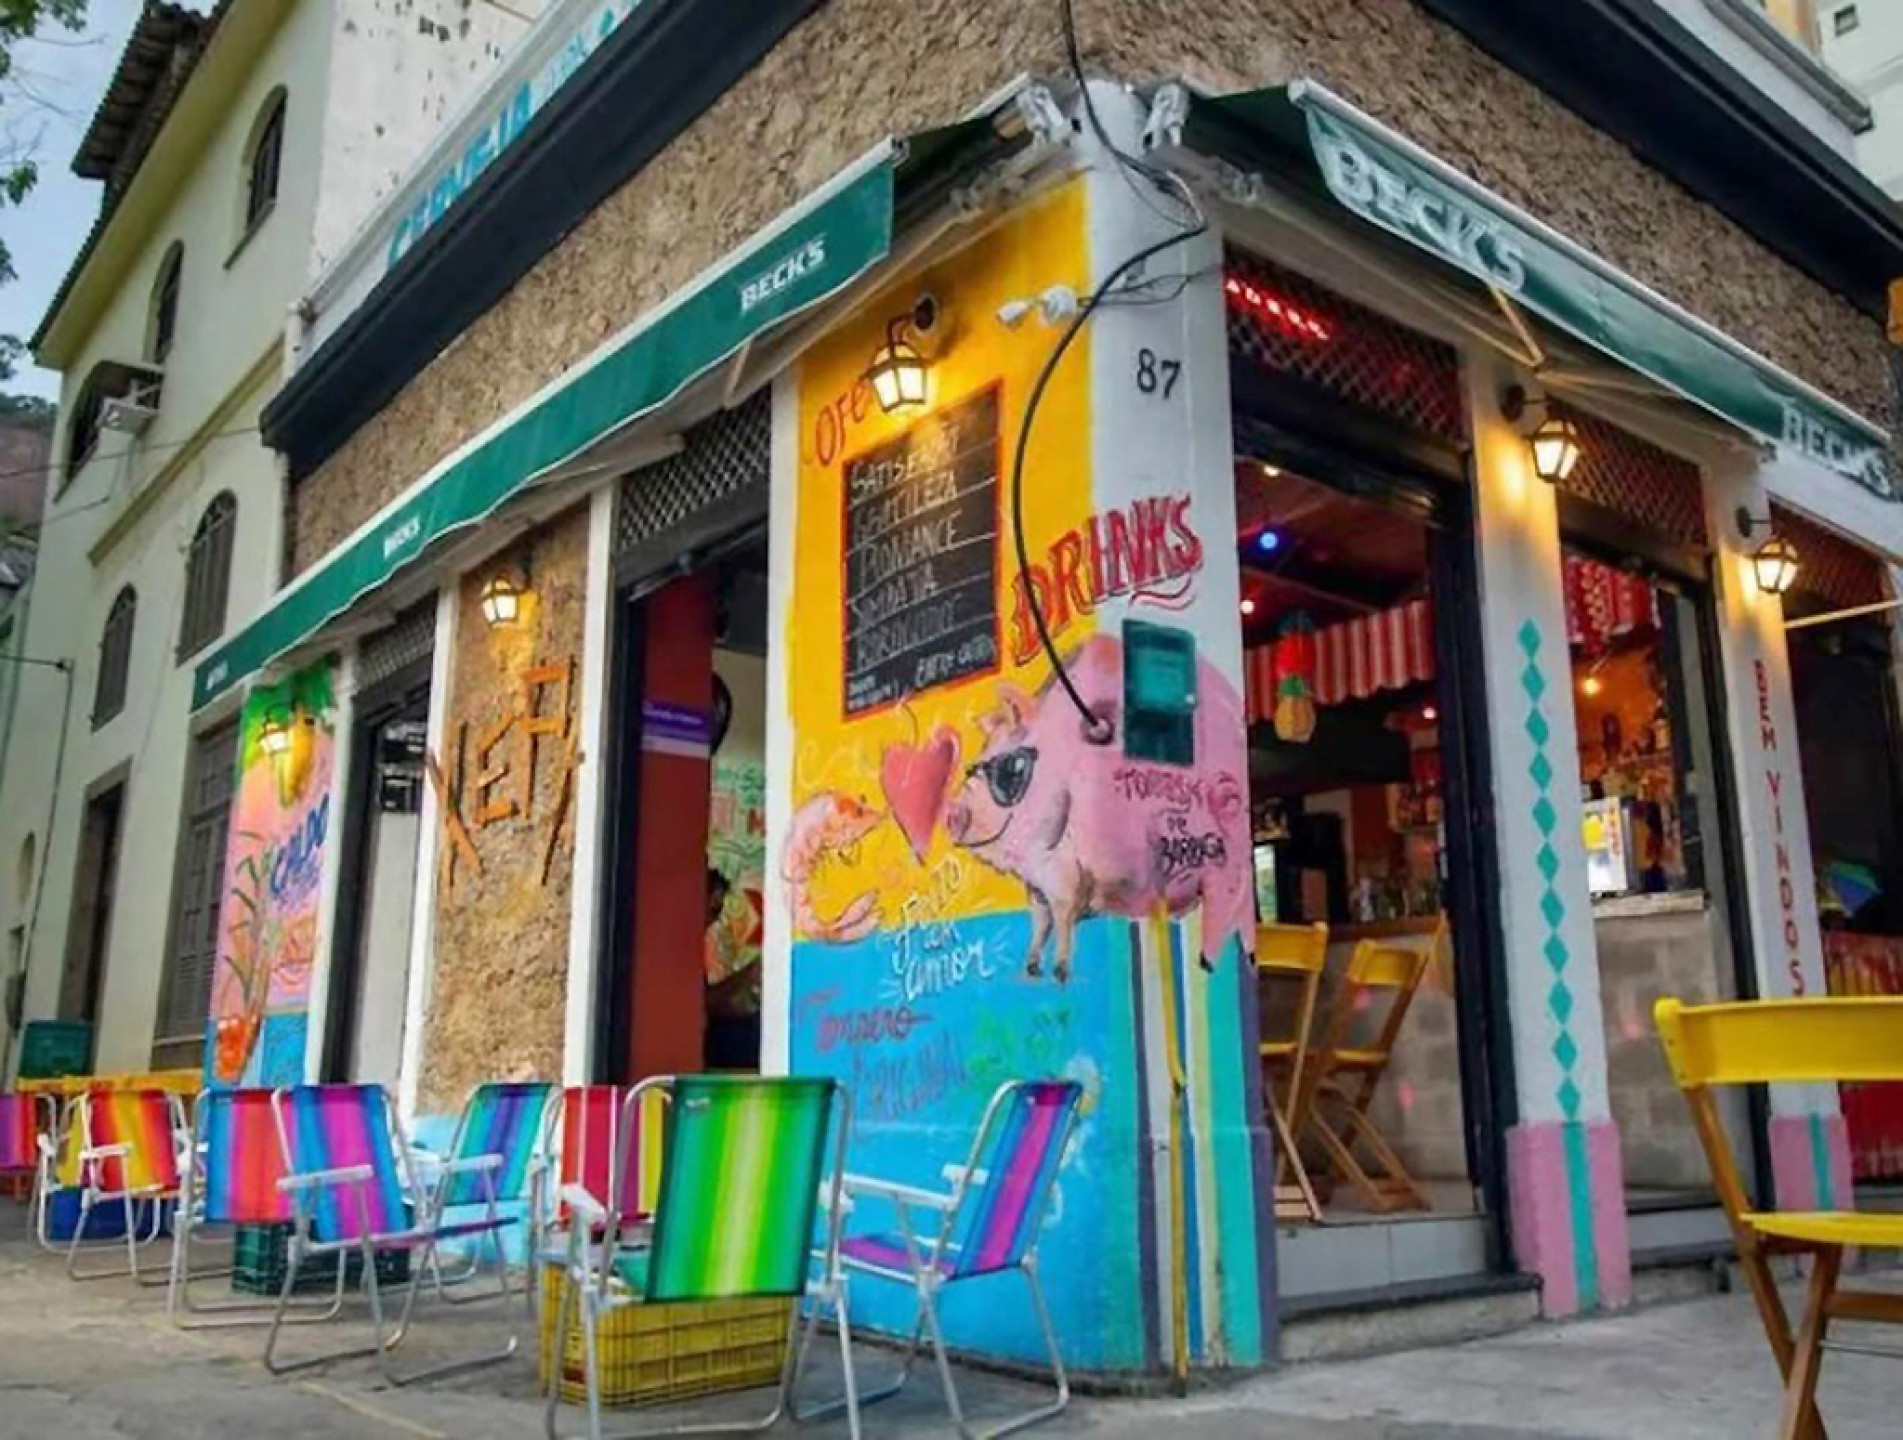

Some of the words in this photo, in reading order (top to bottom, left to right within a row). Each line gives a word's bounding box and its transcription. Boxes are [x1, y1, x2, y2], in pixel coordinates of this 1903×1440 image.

[1137, 347, 1182, 400] 87
[1011, 494, 1204, 667] DRINKS
[1765, 768, 1806, 998] VINDOS
